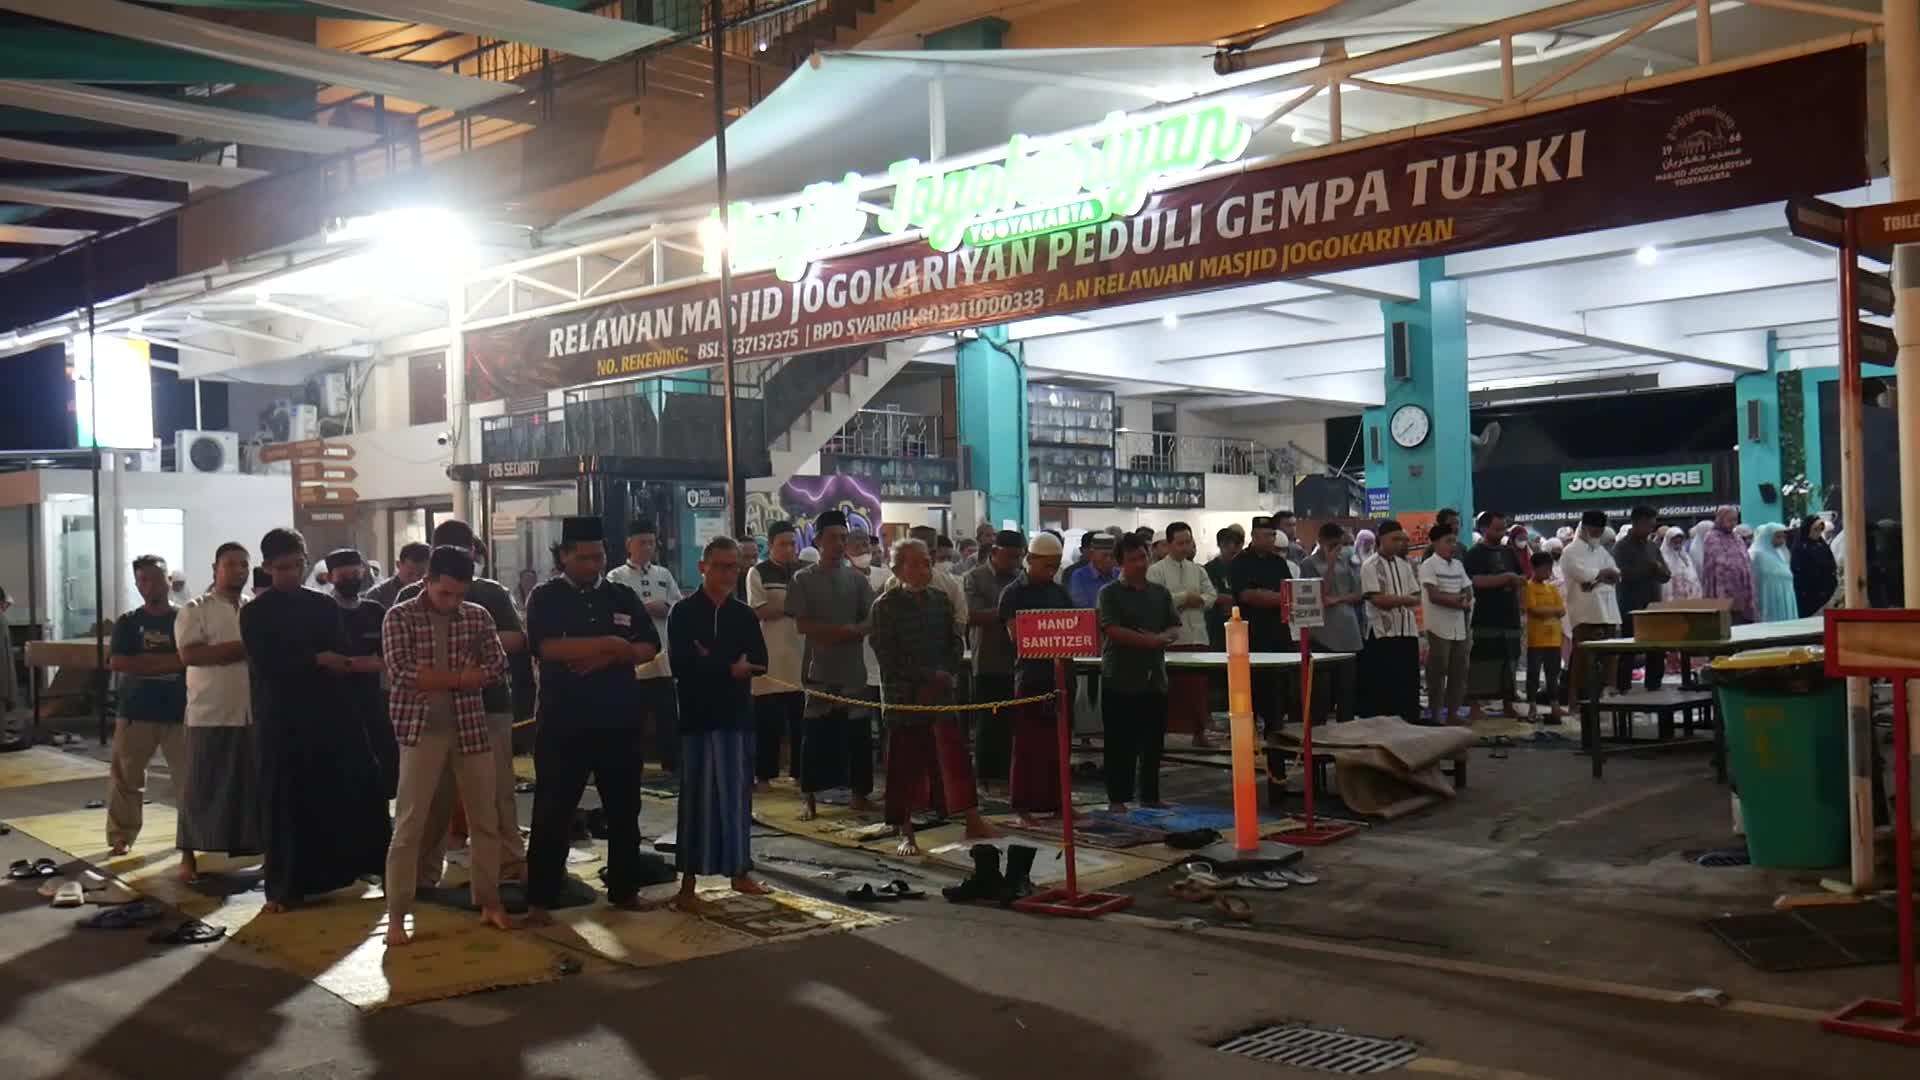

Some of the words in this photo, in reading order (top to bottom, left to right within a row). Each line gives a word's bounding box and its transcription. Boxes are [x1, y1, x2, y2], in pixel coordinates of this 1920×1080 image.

[549, 306, 674, 358] RELAWAN
[790, 237, 1037, 323] JOGOKARIYAN
[1048, 203, 1203, 272] PEDULI
[1216, 169, 1391, 240] GEMPA
[1406, 129, 1587, 207] TURKI
[597, 358, 618, 376] NO.
[621, 347, 689, 372] REKENING:
[698, 341, 719, 360] BSI
[813, 321, 843, 342] BPD
[846, 311, 915, 337] SYARIAH
[1094, 261, 1194, 297] RELAWAN
[1200, 247, 1277, 279] MASJID
[1281, 217, 1454, 272] JOGOKARIYAN
[1568, 471, 1701, 491] JOGOSTORE
[1022, 635, 1092, 648] SANITIZER
